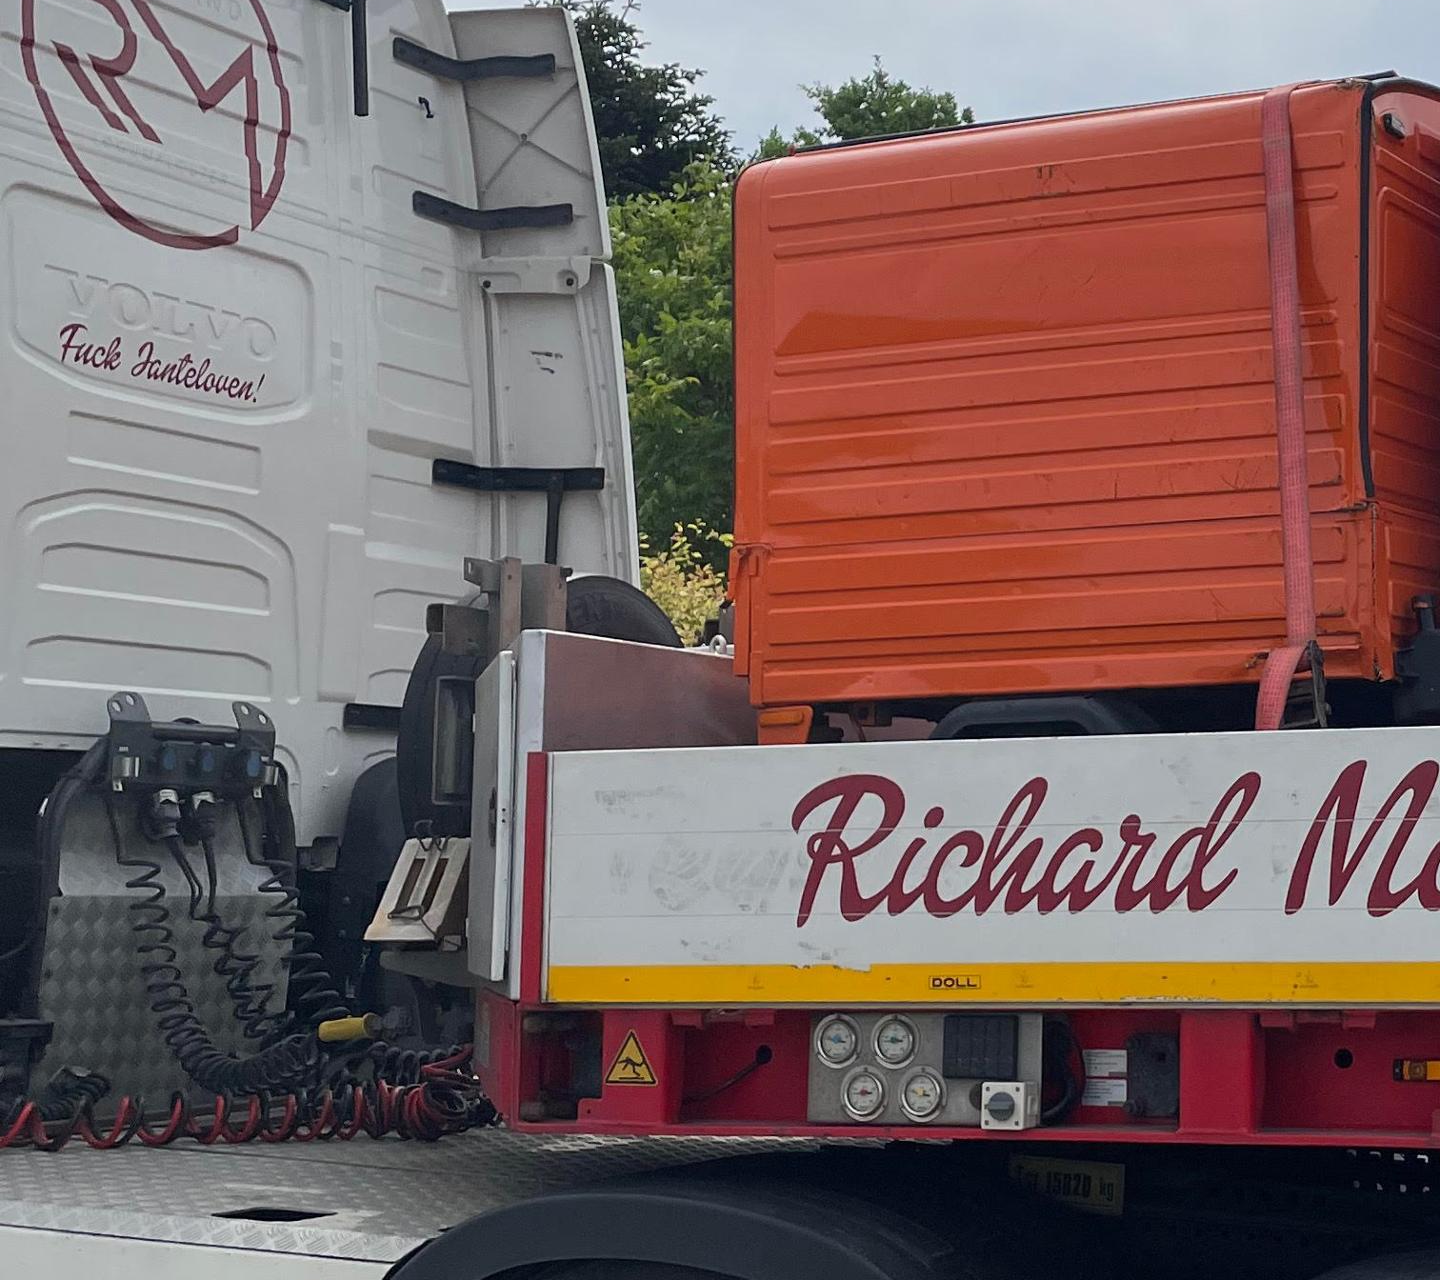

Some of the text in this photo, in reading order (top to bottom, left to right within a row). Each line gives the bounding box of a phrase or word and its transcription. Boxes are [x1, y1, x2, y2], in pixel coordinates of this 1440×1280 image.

[44, 263, 277, 362] VOLVO
[60, 323, 266, 403] Fuck Janteloven!
[791, 773, 1262, 928] Richard
[932, 977, 977, 988] DOLL
